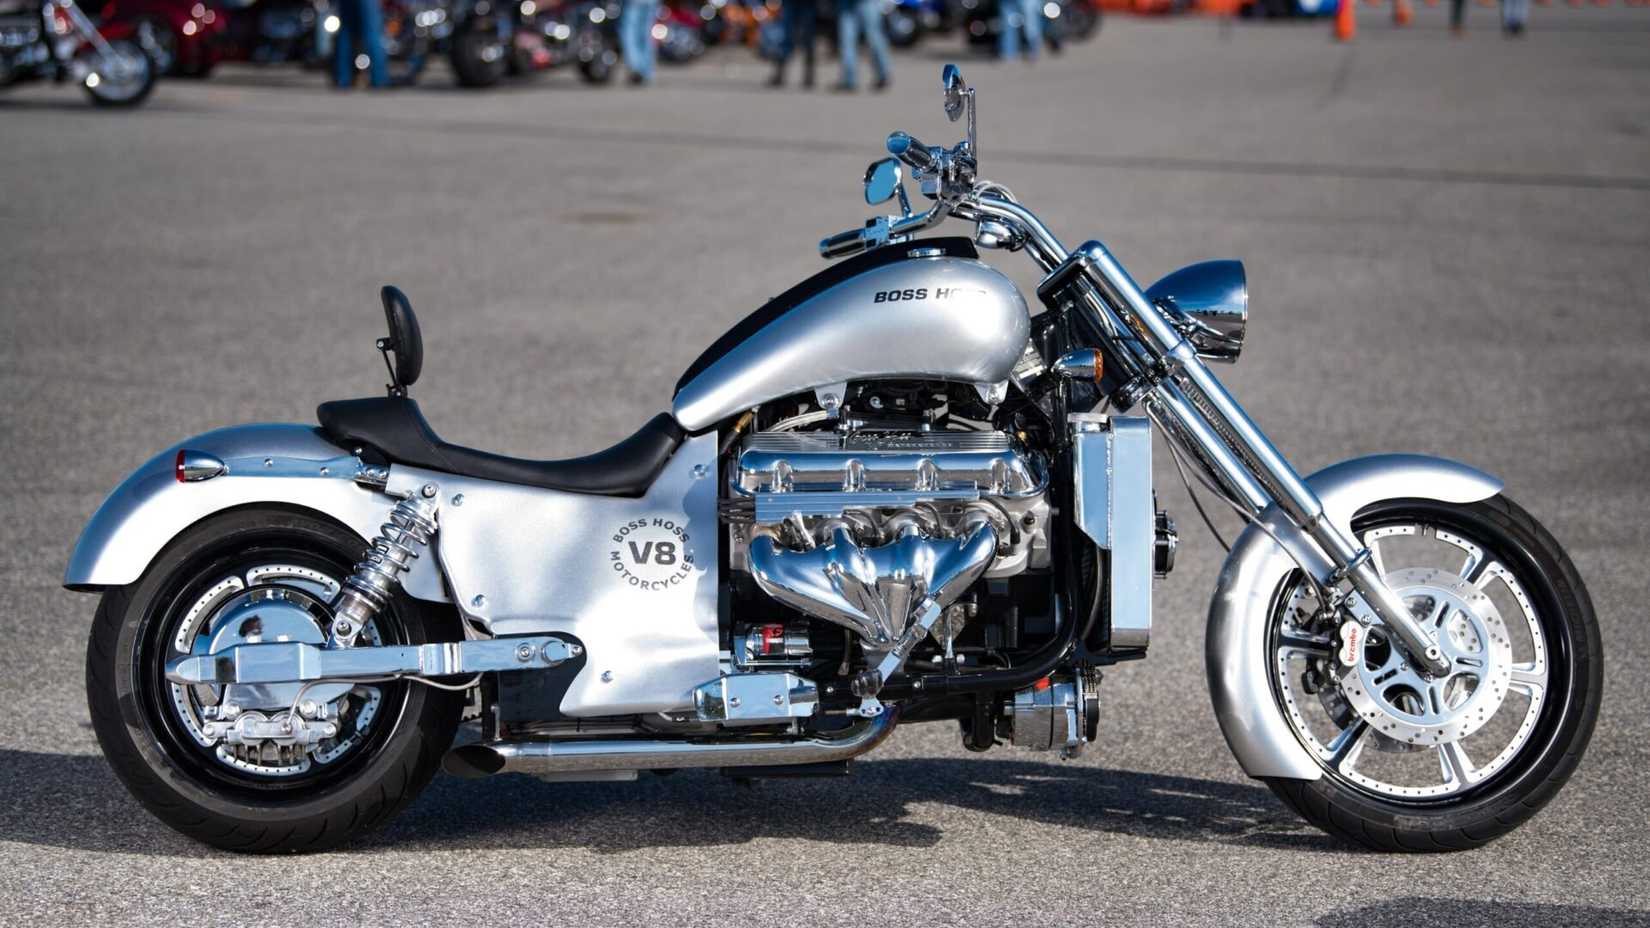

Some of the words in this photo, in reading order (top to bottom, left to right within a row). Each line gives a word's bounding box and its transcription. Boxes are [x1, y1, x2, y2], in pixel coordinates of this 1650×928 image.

[874, 288, 928, 303] BOSS
[613, 518, 648, 543] BOSS
[652, 518, 690, 543] HOSS
[628, 541, 676, 565] V8
[610, 551, 694, 591] MOTORCYCLES
[1347, 628, 1357, 662] brembo
